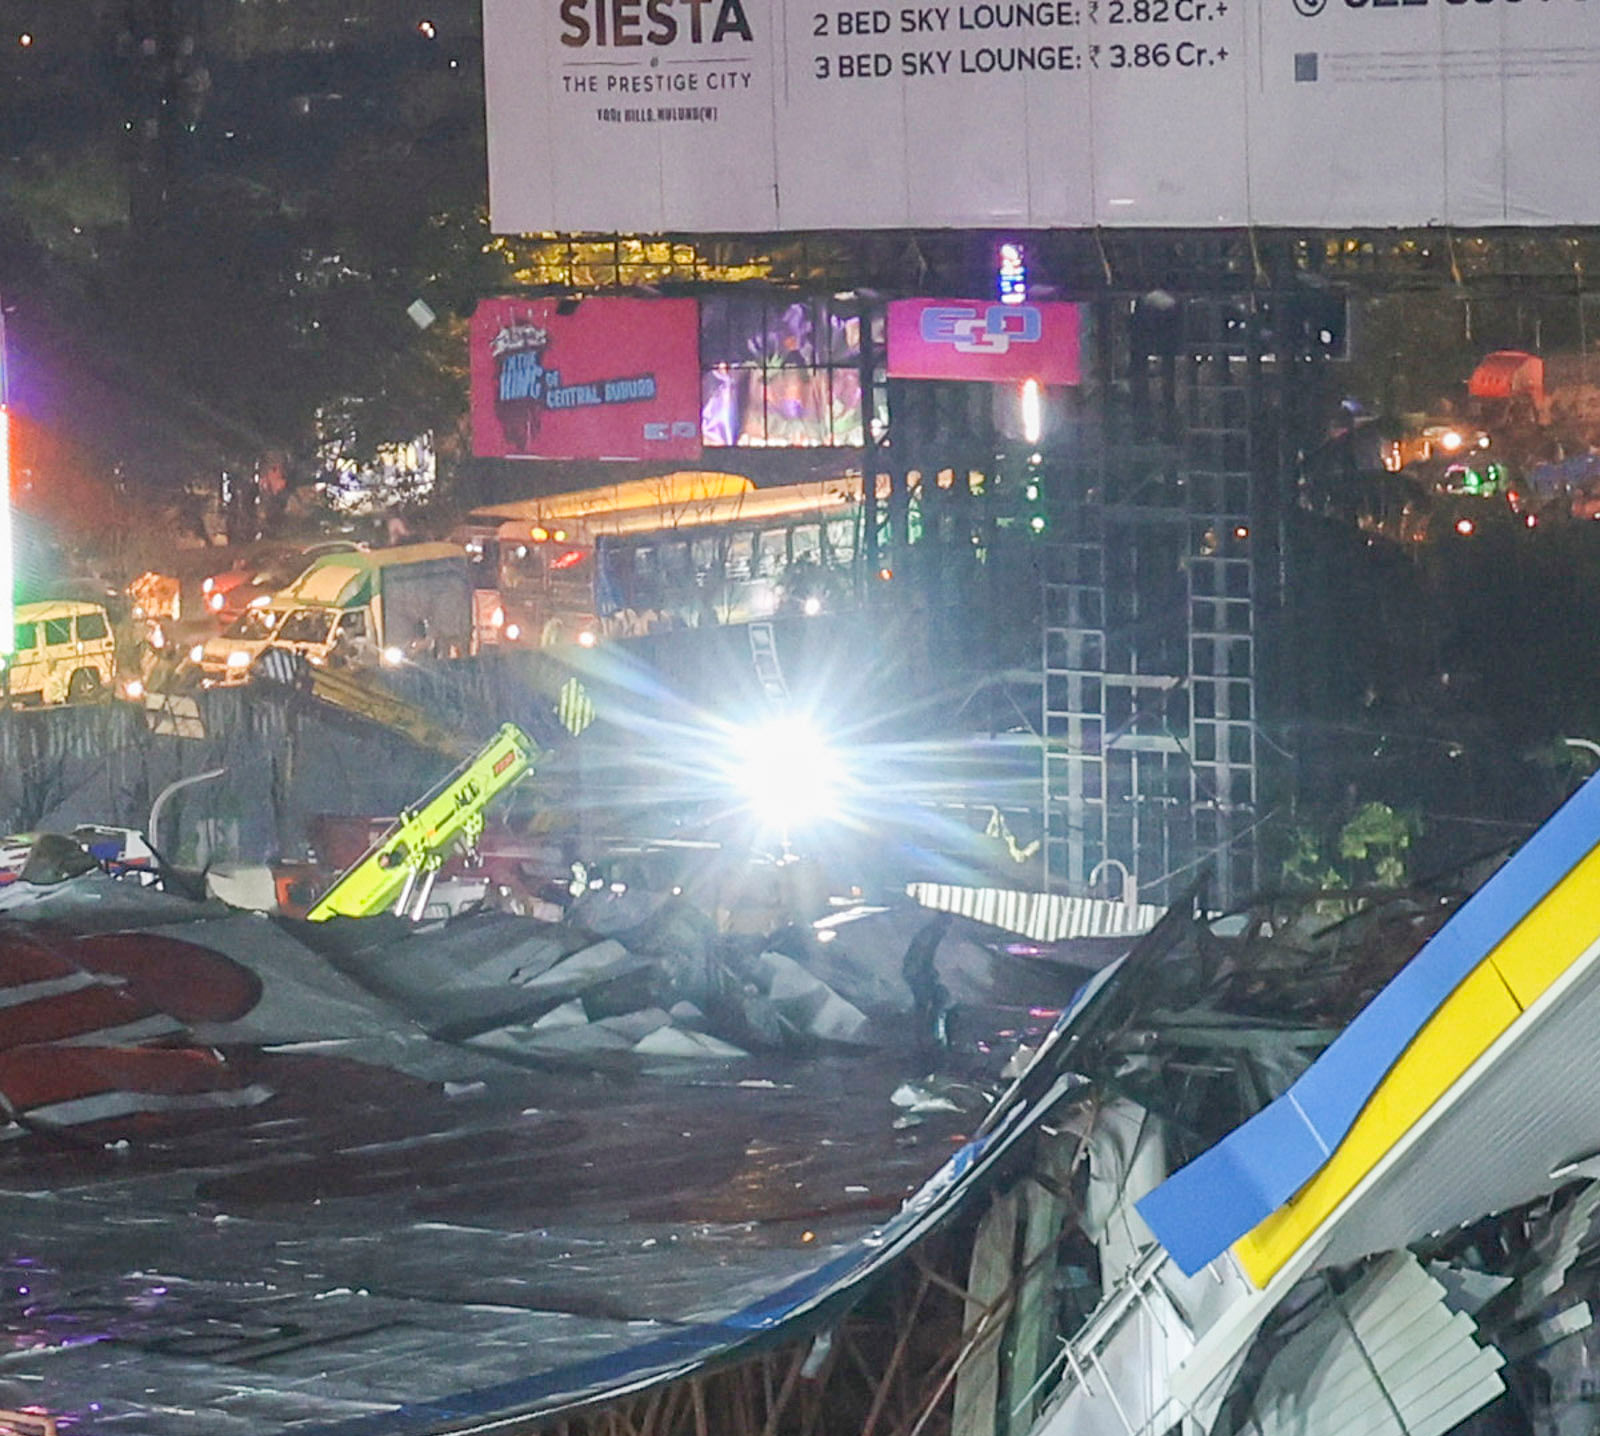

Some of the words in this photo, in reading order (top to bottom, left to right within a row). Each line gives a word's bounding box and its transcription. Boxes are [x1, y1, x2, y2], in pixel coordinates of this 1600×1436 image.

[560, 0, 753, 47] SIESTA
[813, 13, 828, 36] 2
[837, 10, 891, 35] BED
[900, 8, 950, 32] SKY
[959, 2, 1080, 30] LOUNGE:
[1108, 0, 1169, 24] 2.82
[814, 56, 830, 79] 3
[838, 53, 893, 78] BED
[902, 51, 952, 76] SKY
[960, 46, 1081, 72] LOUNGE:
[1109, 43, 1171, 68] 3.86
[563, 76, 598, 92] THE
[607, 73, 698, 93] PRESTIGE
[706, 72, 751, 90] CITY
[546, 385, 602, 409] CENTRAL
